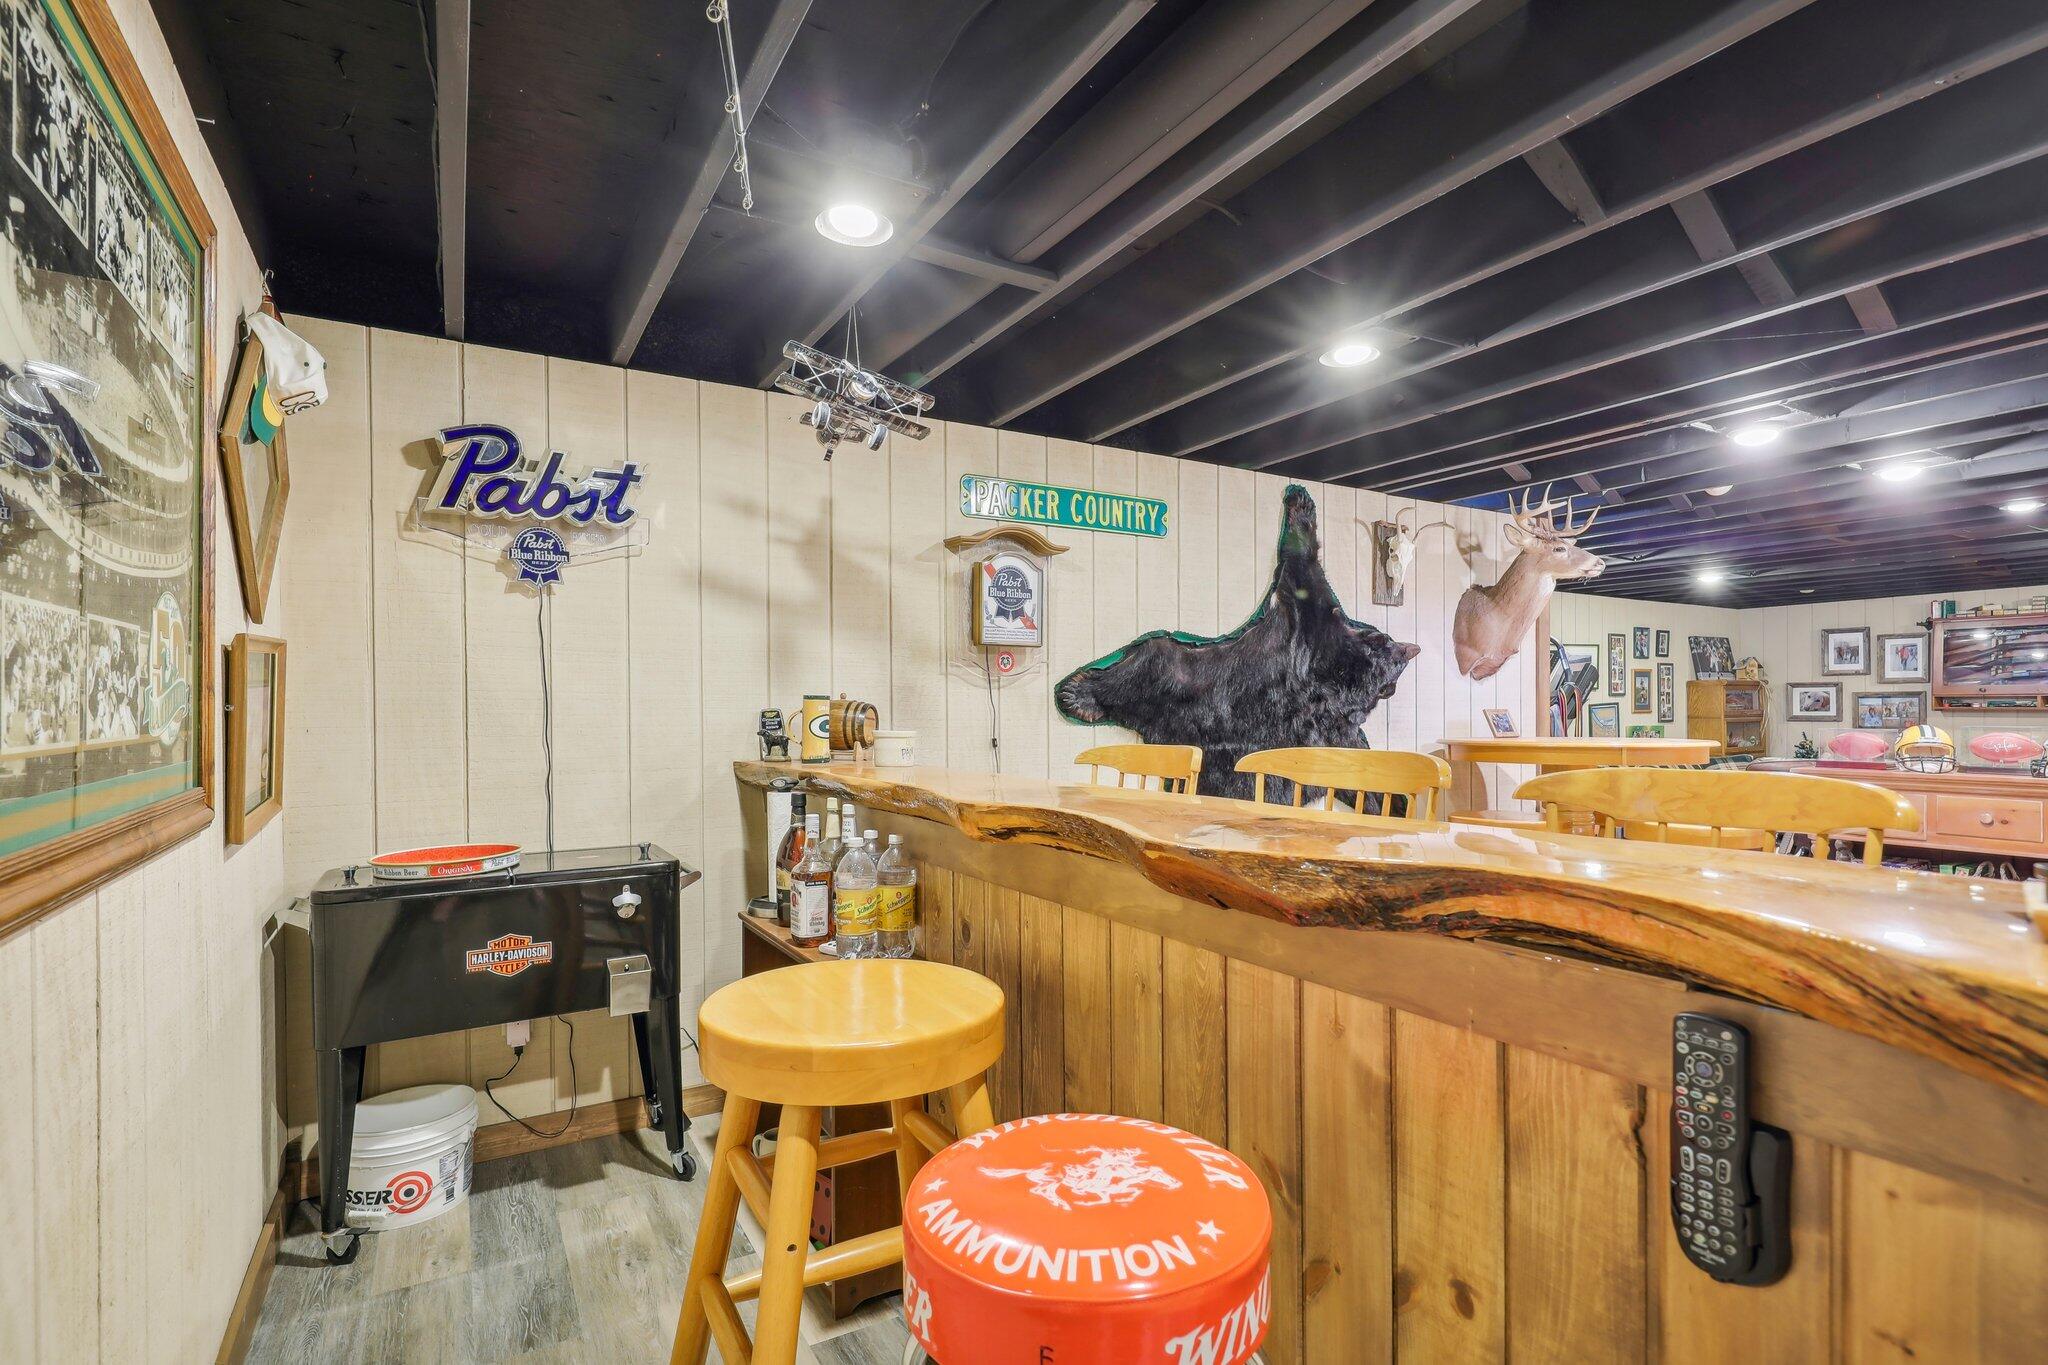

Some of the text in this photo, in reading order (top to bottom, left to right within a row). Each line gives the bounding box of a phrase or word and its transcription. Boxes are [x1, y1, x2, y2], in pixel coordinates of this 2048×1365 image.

[441, 424, 643, 525] Pabst
[974, 480, 1160, 532] PACKER COUNTRY
[522, 533, 555, 549] Pabst
[510, 548, 569, 562] Blue Ribbon
[997, 573, 1023, 587] Pabst
[989, 587, 1031, 599] Blue Ribbon
[493, 937, 526, 950] MOTOR
[471, 946, 548, 965] HARLEY-DAVIDSON
[494, 961, 527, 973] CYCLES
[918, 1197, 1197, 1283] AMMUNITION
